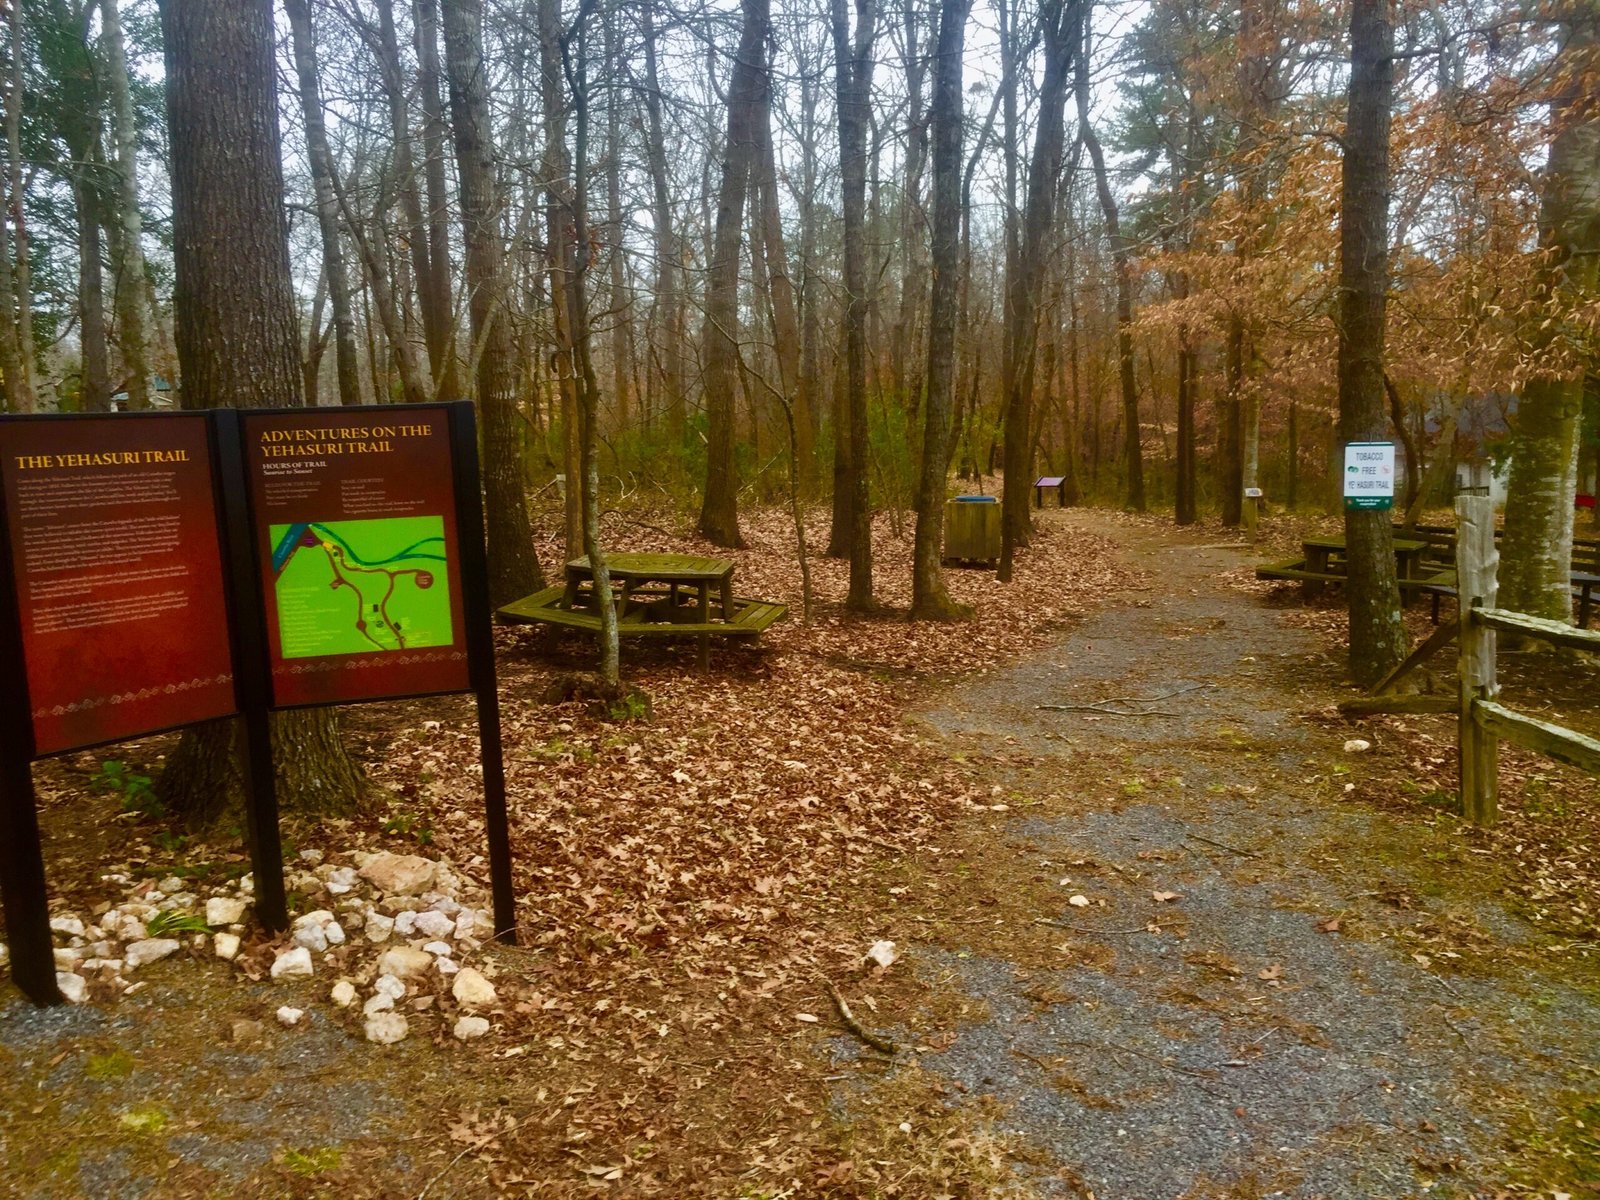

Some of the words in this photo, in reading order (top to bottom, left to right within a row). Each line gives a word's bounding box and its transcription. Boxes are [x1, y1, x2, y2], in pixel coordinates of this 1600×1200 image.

[261, 428, 369, 442] ADVENTURES
[372, 425, 396, 438] ON
[399, 425, 433, 437] THE
[262, 443, 343, 457] YEHASURI
[345, 441, 394, 454] TRAIL
[15, 455, 53, 469] THE
[56, 452, 140, 467] YEHASURI
[143, 450, 190, 463] TRAIL
[1356, 452, 1384, 461] TOBACCO
[262, 462, 291, 470] HOURS
[303, 460, 327, 468] TRAIL
[1361, 466, 1377, 475] FREE
[1375, 480, 1390, 489] TRAIL
